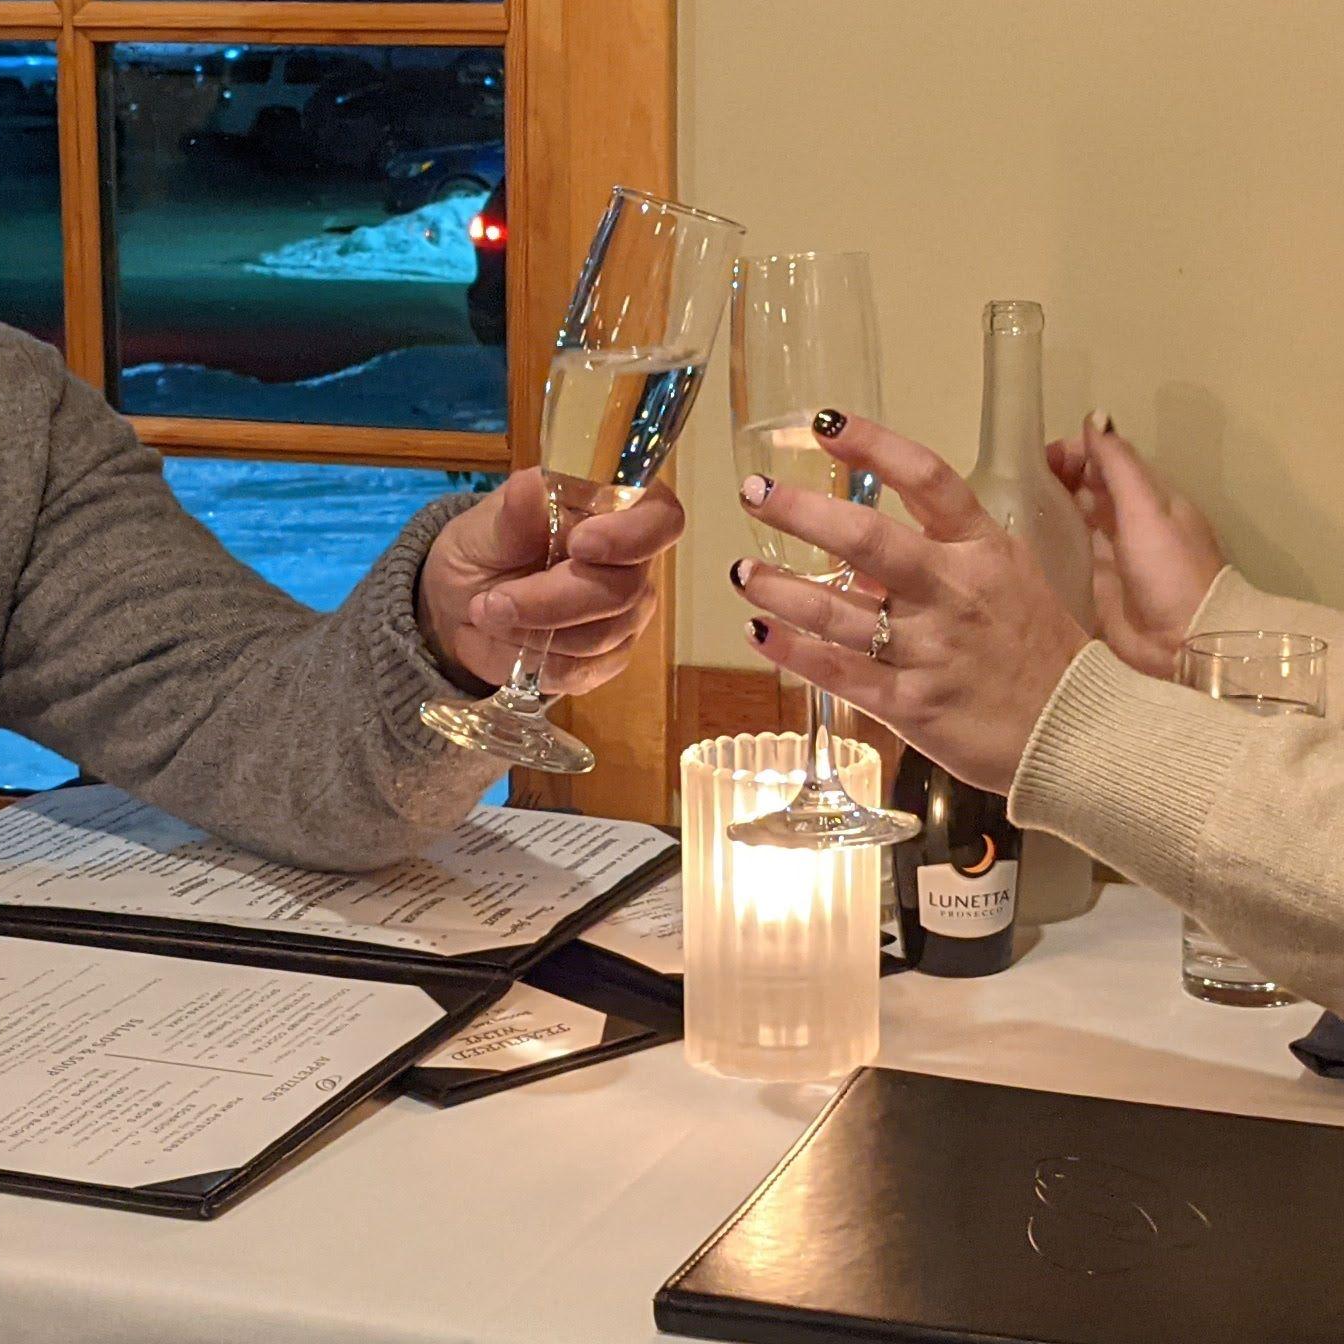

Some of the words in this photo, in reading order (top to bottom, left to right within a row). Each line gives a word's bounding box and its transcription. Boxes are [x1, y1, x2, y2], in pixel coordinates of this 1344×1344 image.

[929, 889, 1010, 909] LUNETTA
[940, 906, 1004, 918] PROSECCO
[91, 1018, 143, 1047] SALADS
[451, 1023, 570, 1060] FEATURED
[44, 1055, 82, 1076] SOUP
[262, 1056, 331, 1102] APPETIZERS
